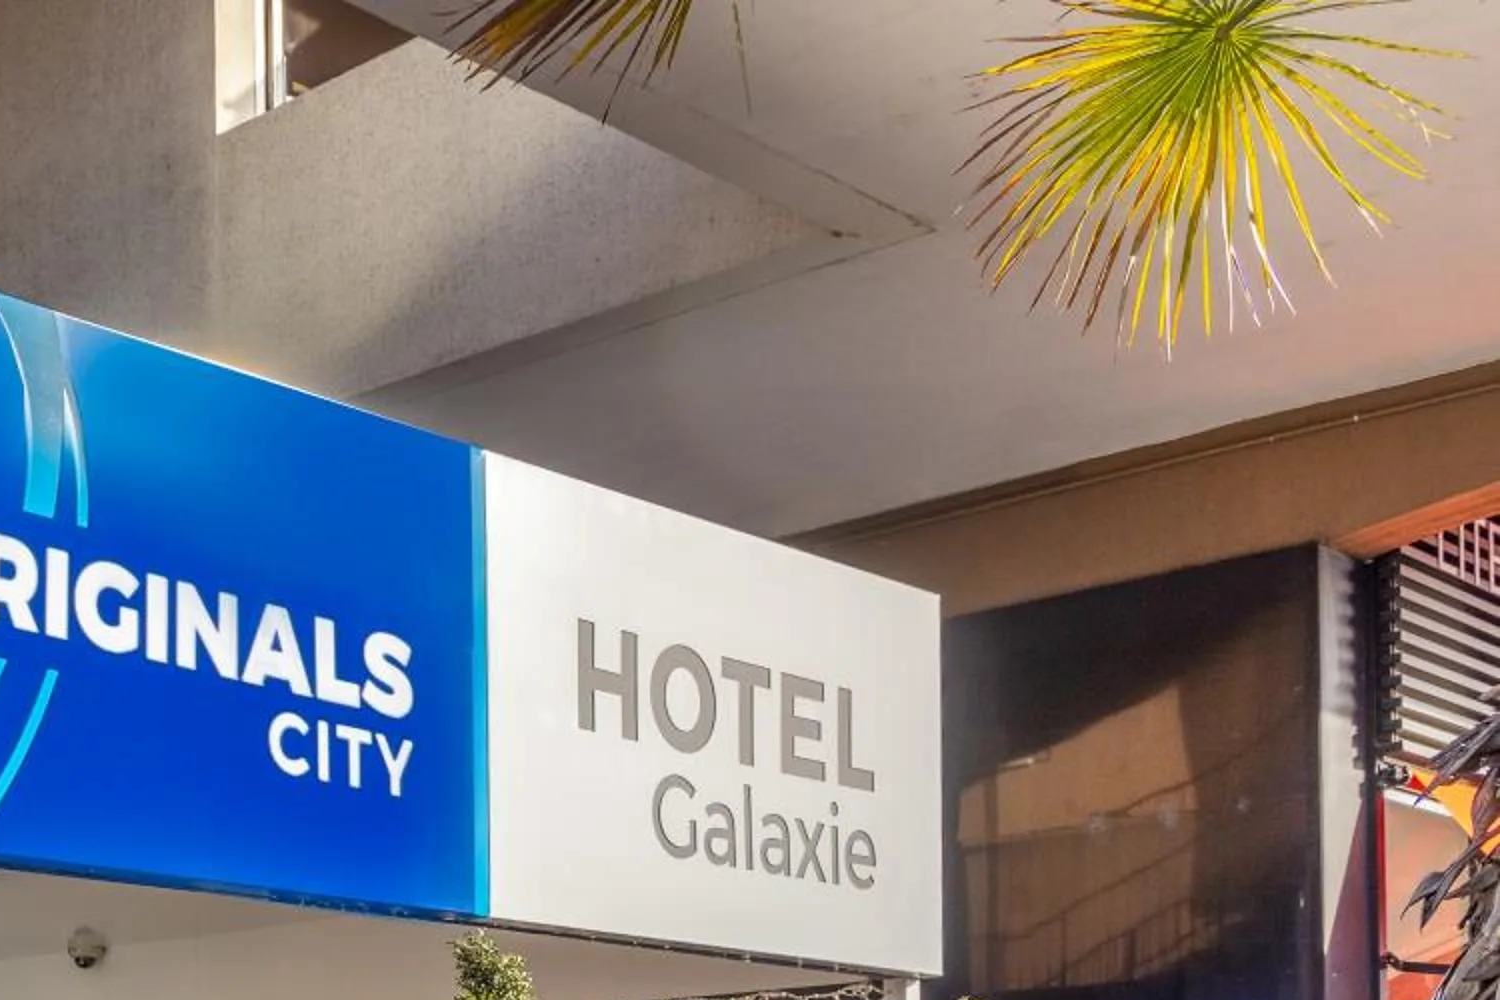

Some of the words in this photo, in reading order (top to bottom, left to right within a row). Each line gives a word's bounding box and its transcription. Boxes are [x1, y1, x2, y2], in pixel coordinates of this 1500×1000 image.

[268, 712, 414, 797] CITY
[577, 617, 875, 792] HOTEL
[651, 774, 877, 890] Galaxie
